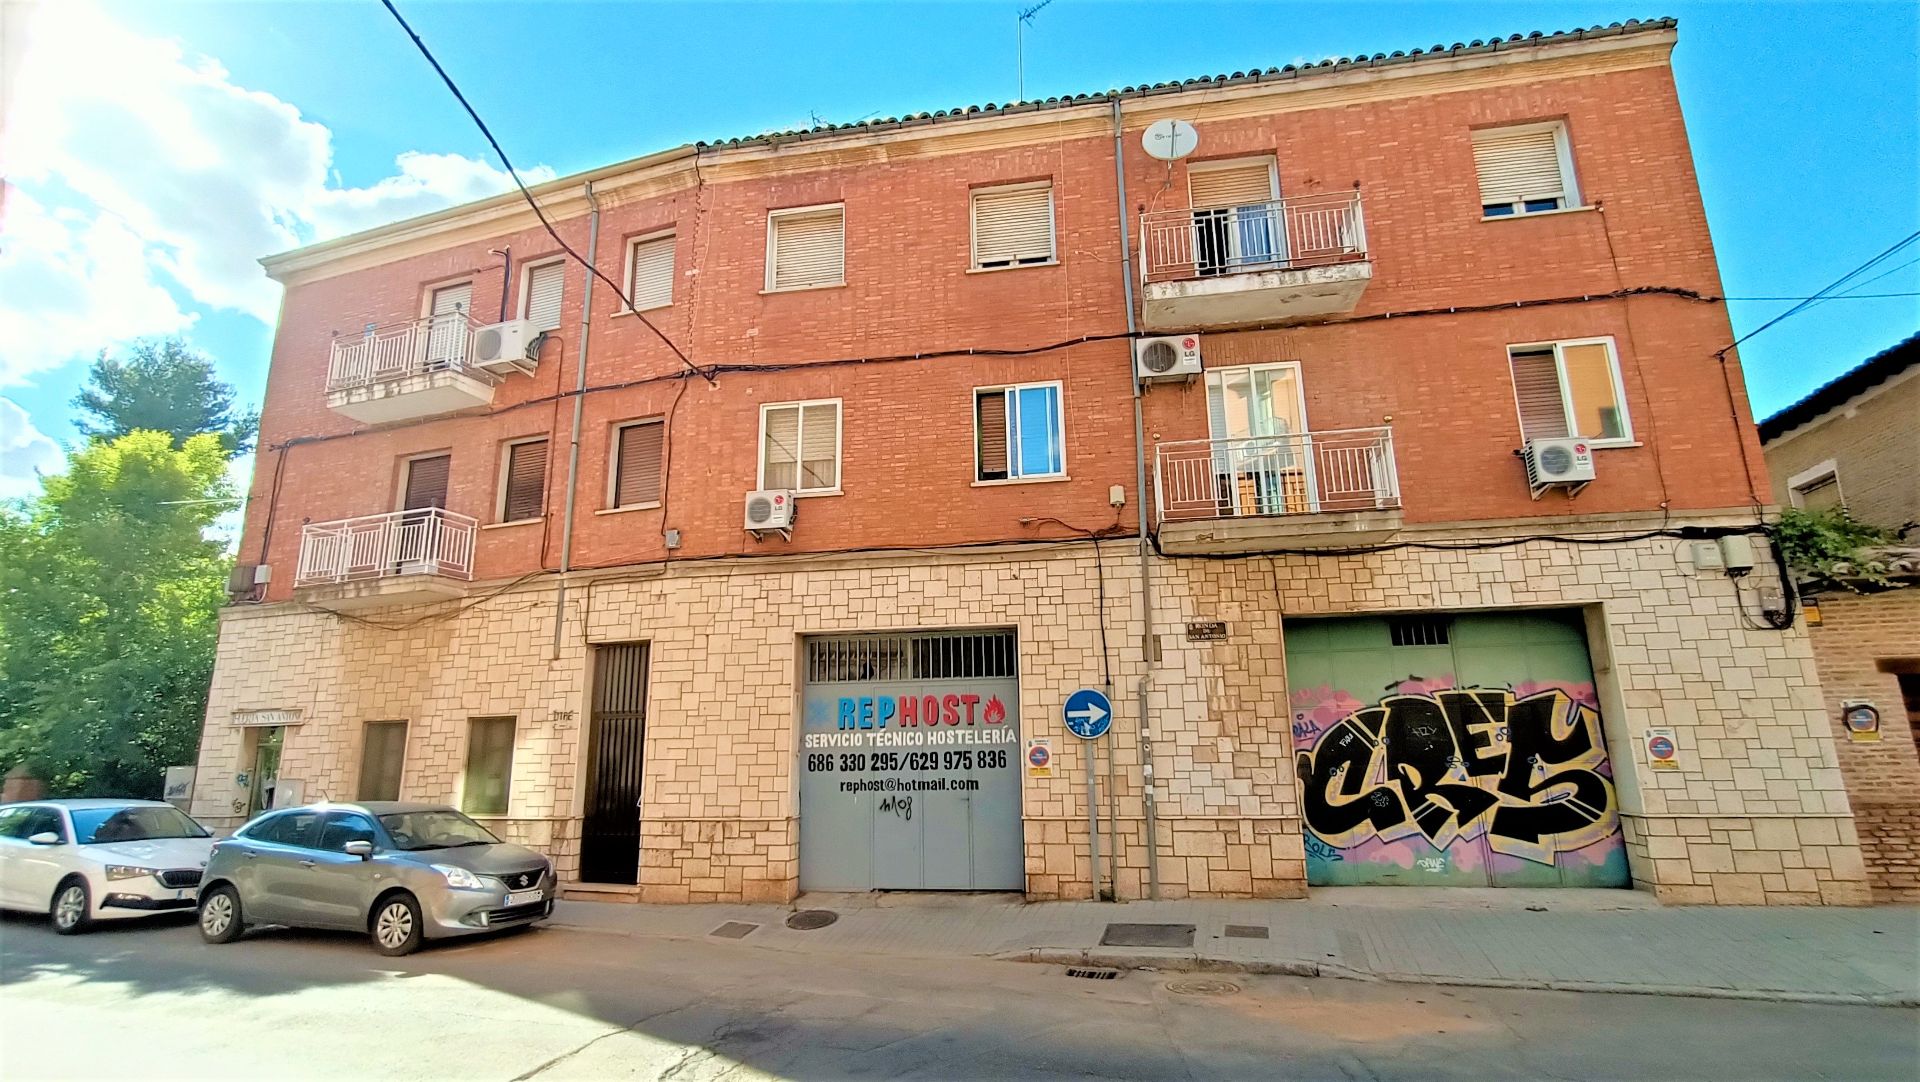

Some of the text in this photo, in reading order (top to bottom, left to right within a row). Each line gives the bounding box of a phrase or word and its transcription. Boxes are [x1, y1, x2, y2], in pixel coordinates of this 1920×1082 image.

[838, 694, 980, 730] REPHOST
[805, 725, 1017, 748] SERVICIO TÉCNICO HOSTELERÍA
[808, 750, 1007, 772] 686 330 295/629 975 836
[840, 778, 979, 794] rephost@hotmail.com
